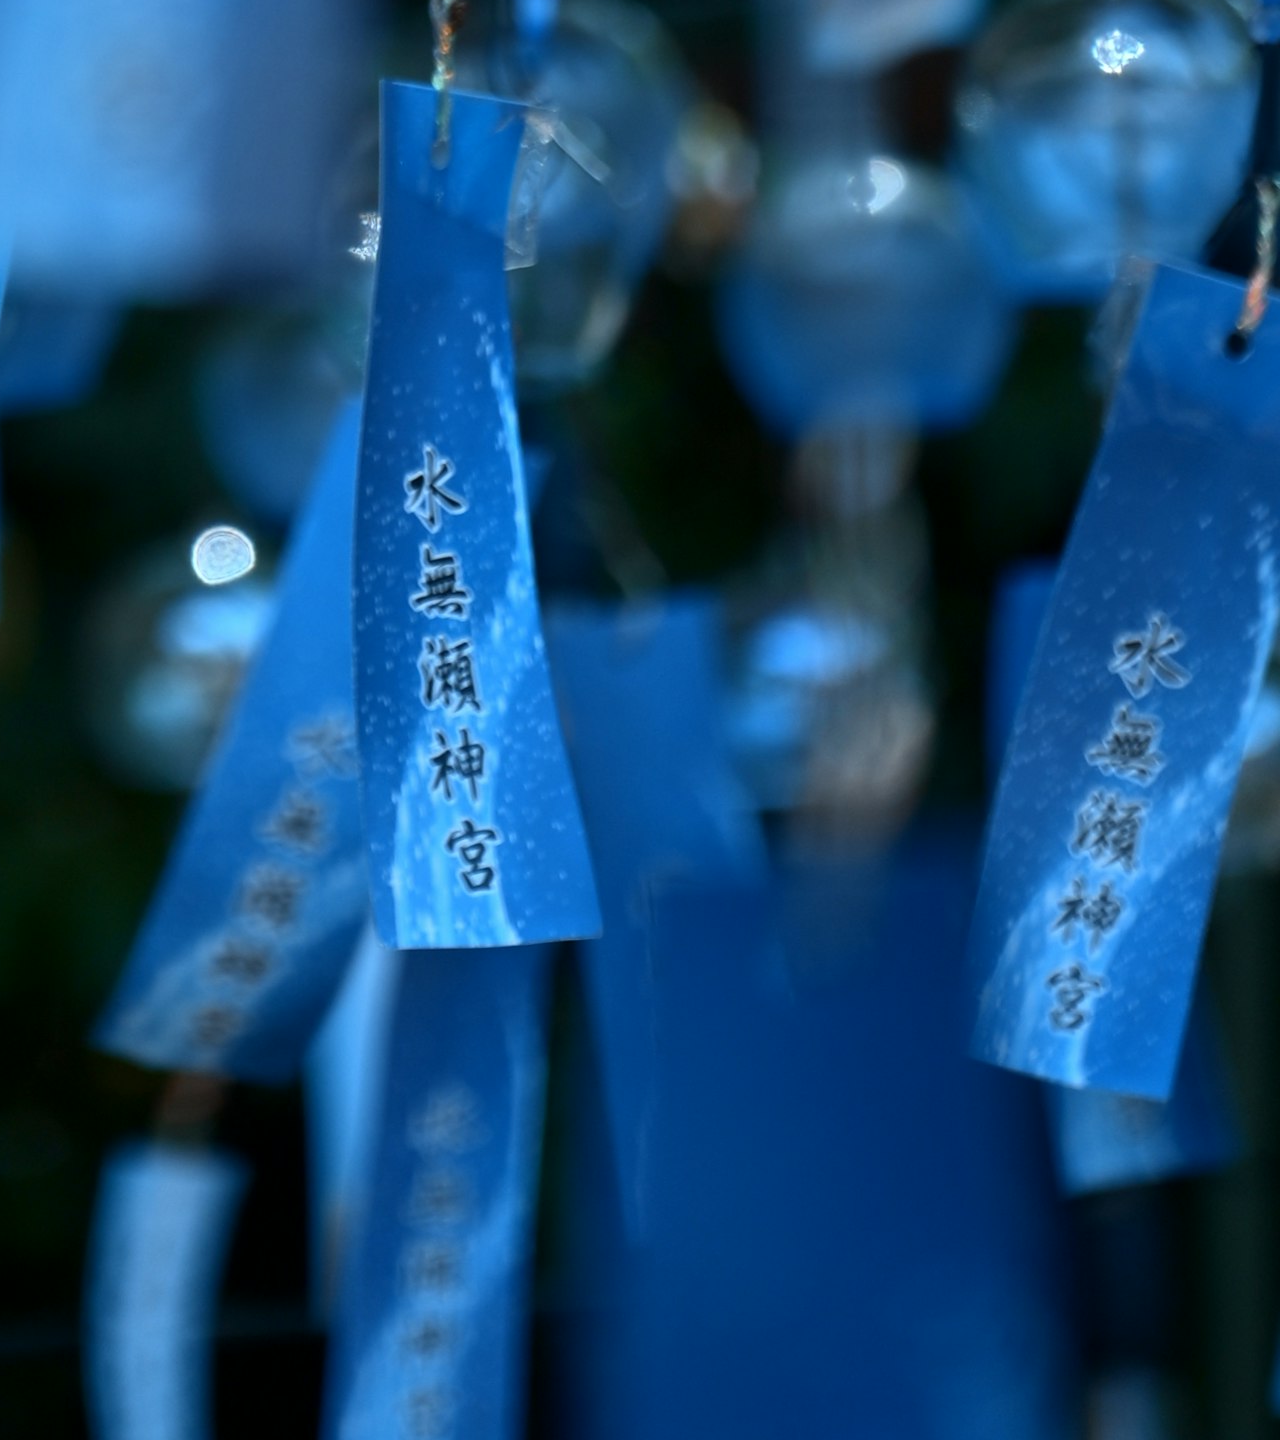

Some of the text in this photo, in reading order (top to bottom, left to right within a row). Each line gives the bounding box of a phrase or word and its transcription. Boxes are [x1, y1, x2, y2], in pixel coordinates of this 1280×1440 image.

[405, 446, 501, 892] 水無瀬神宮
[1045, 613, 1191, 1032] 水無瀬神宮
